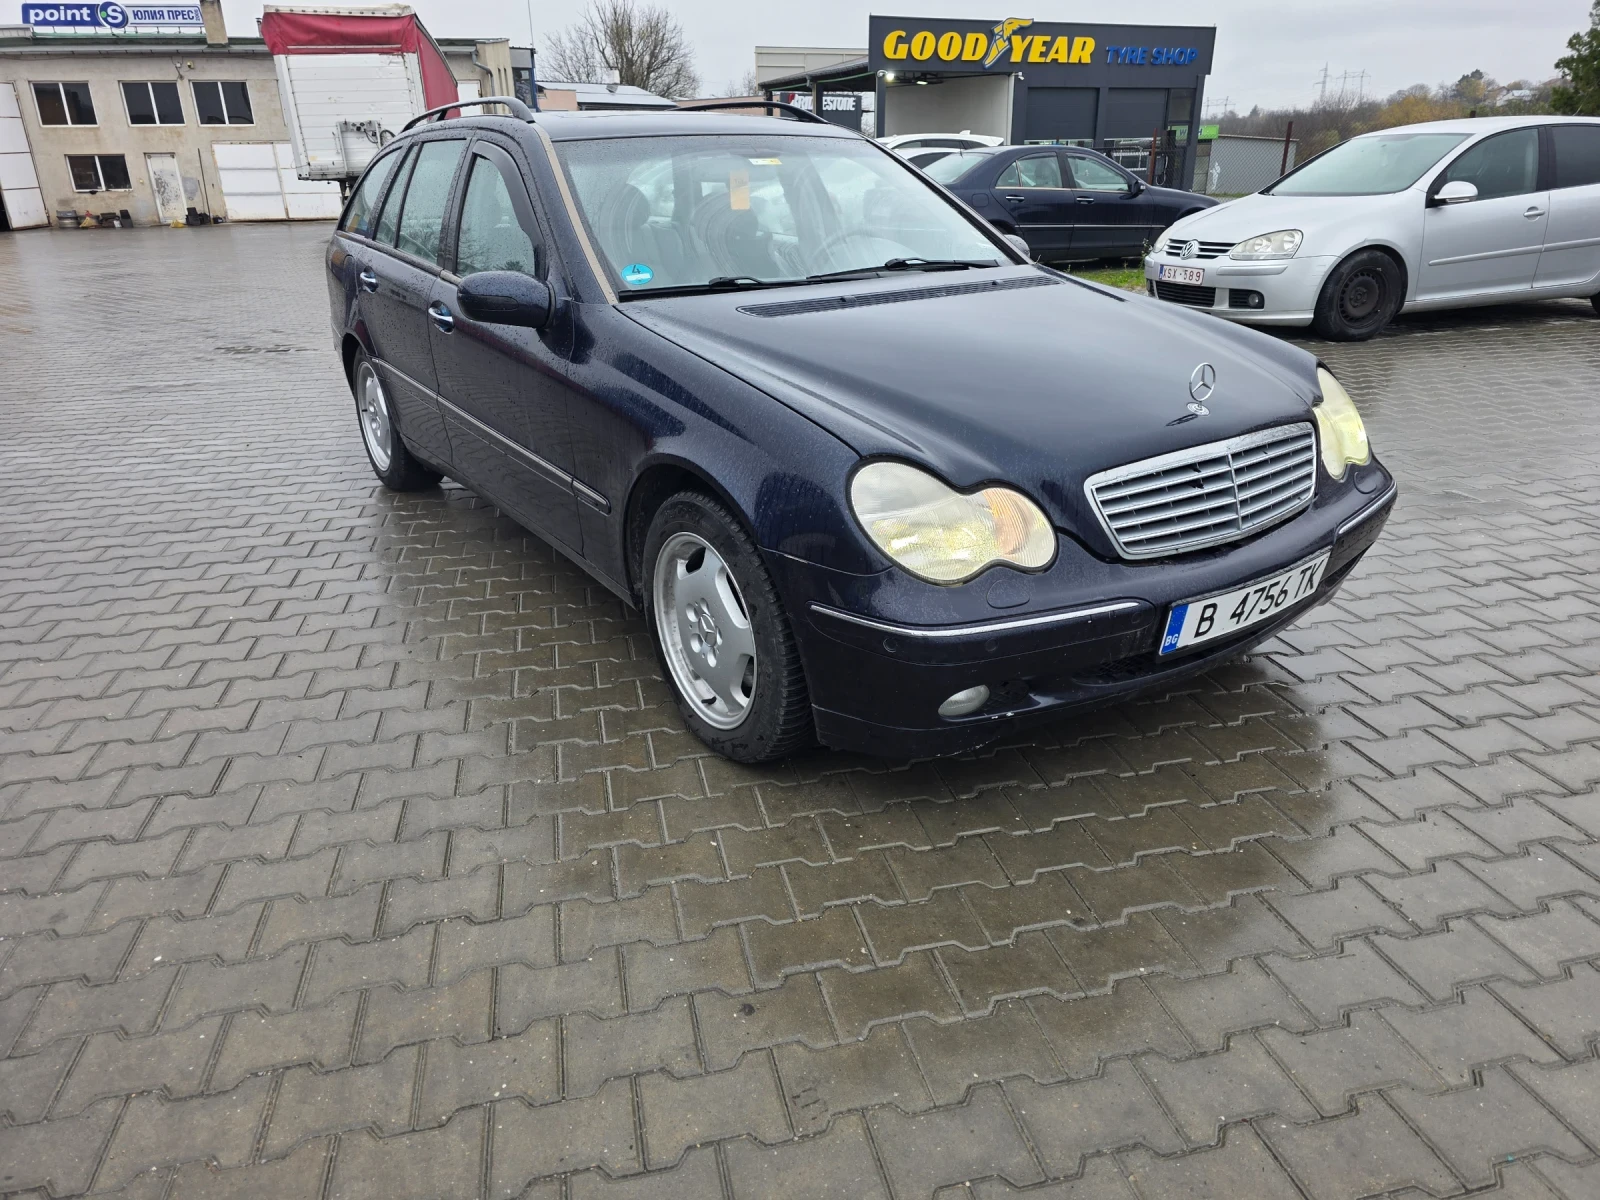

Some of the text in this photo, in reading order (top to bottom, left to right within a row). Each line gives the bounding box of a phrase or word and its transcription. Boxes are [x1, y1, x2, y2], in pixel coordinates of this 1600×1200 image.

[29, 5, 123, 24] point S
[132, 9, 195, 20] ЮЛИЯ ПРЕС
[1105, 46, 1198, 65] TYRE SHOP
[1194, 559, 1325, 638] B 4756 TK
[1164, 633, 1179, 647] BG
